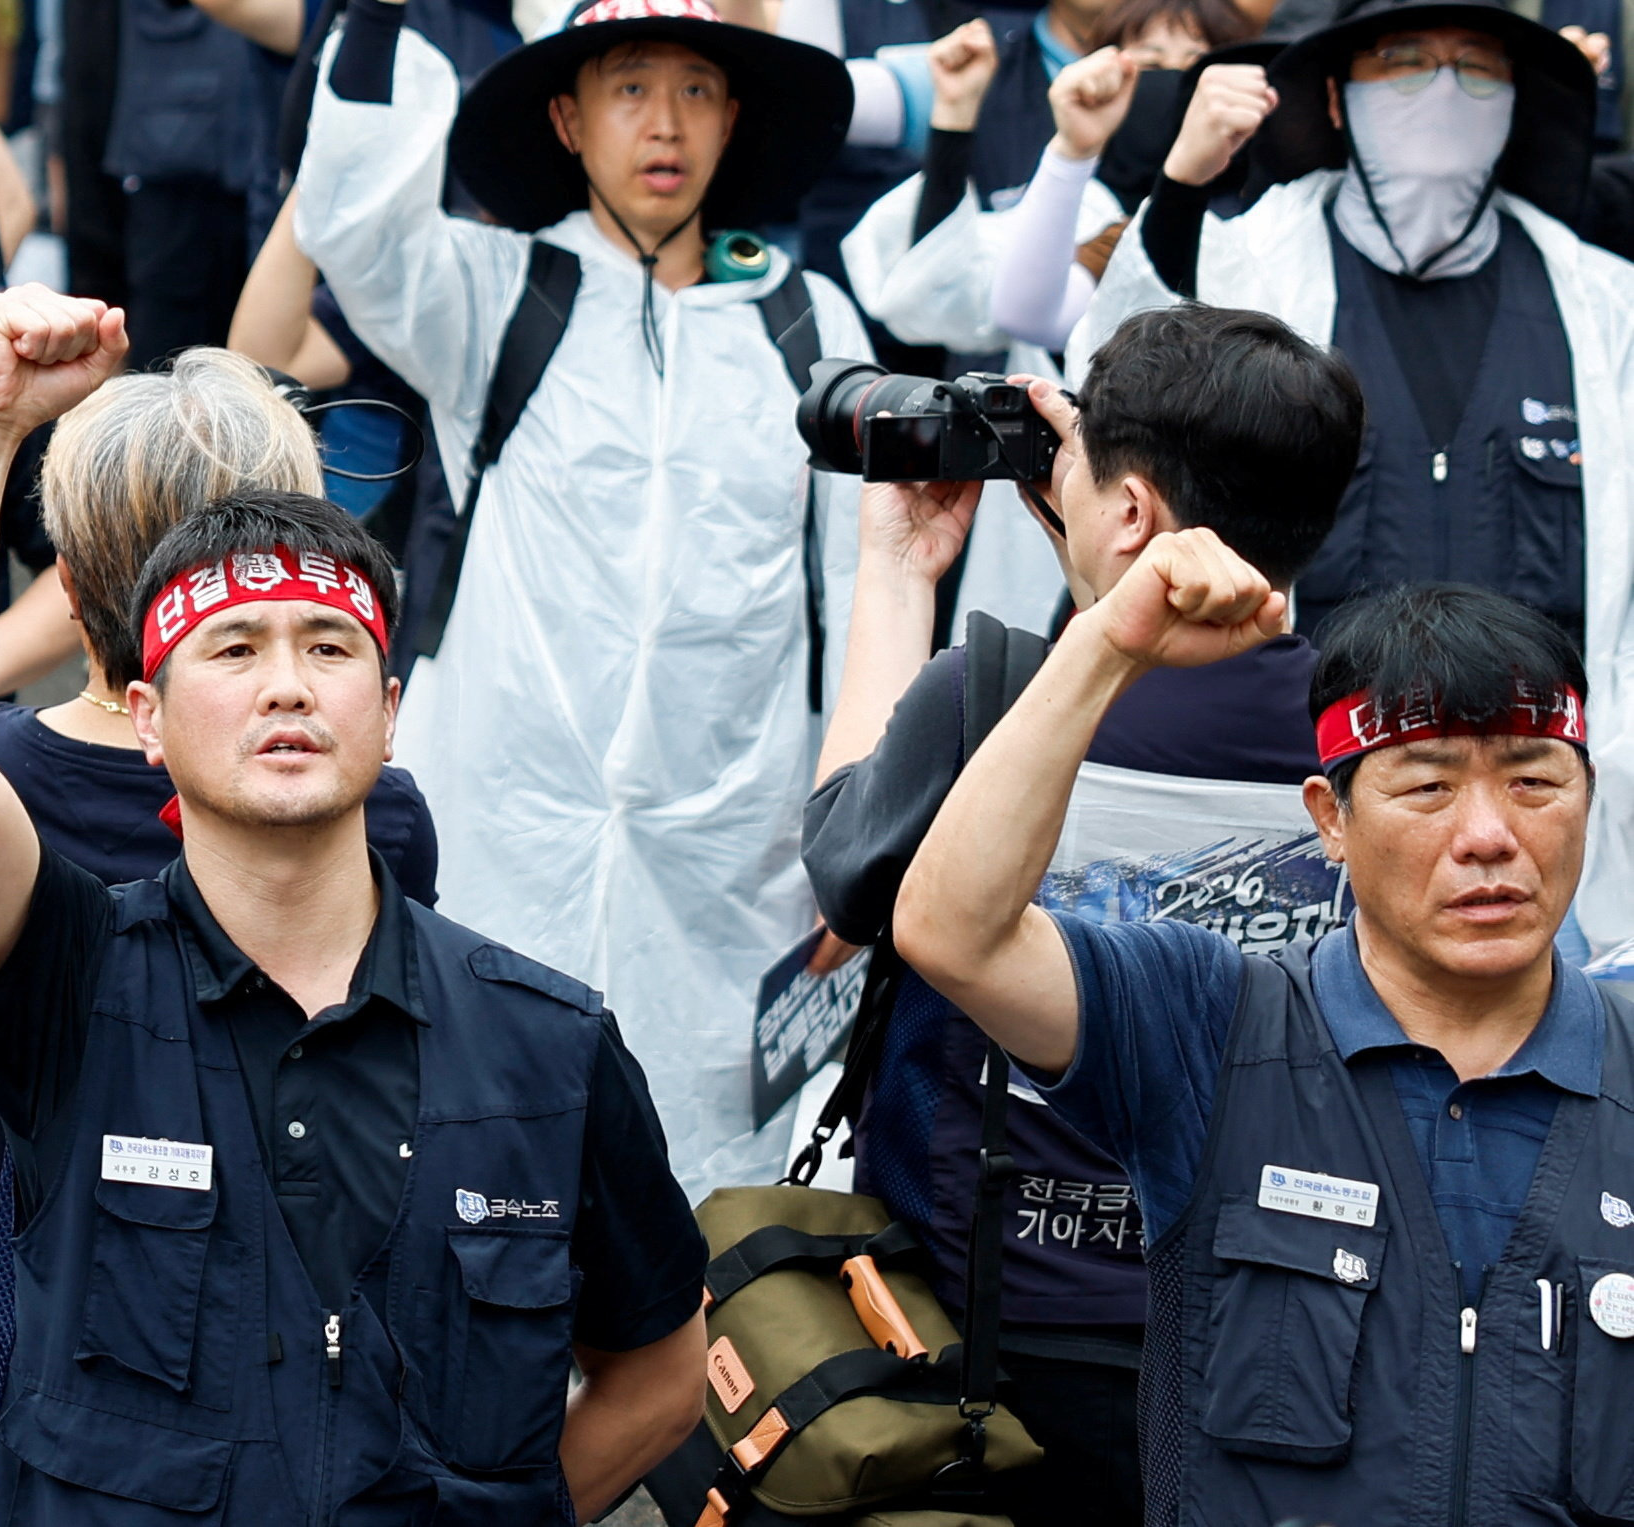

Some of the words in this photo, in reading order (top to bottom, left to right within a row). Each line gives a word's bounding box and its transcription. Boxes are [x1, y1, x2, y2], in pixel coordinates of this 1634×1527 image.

[156, 559, 229, 644] 단결
[299, 551, 375, 621] 투쟁
[490, 1198, 560, 1219] 금속노조
[1019, 1174, 1136, 1212] 전국금
[1294, 1178, 1372, 1201] 전국금속노동조합
[1016, 1208, 1145, 1250] 기아자
[713, 1354, 739, 1397] Canon
